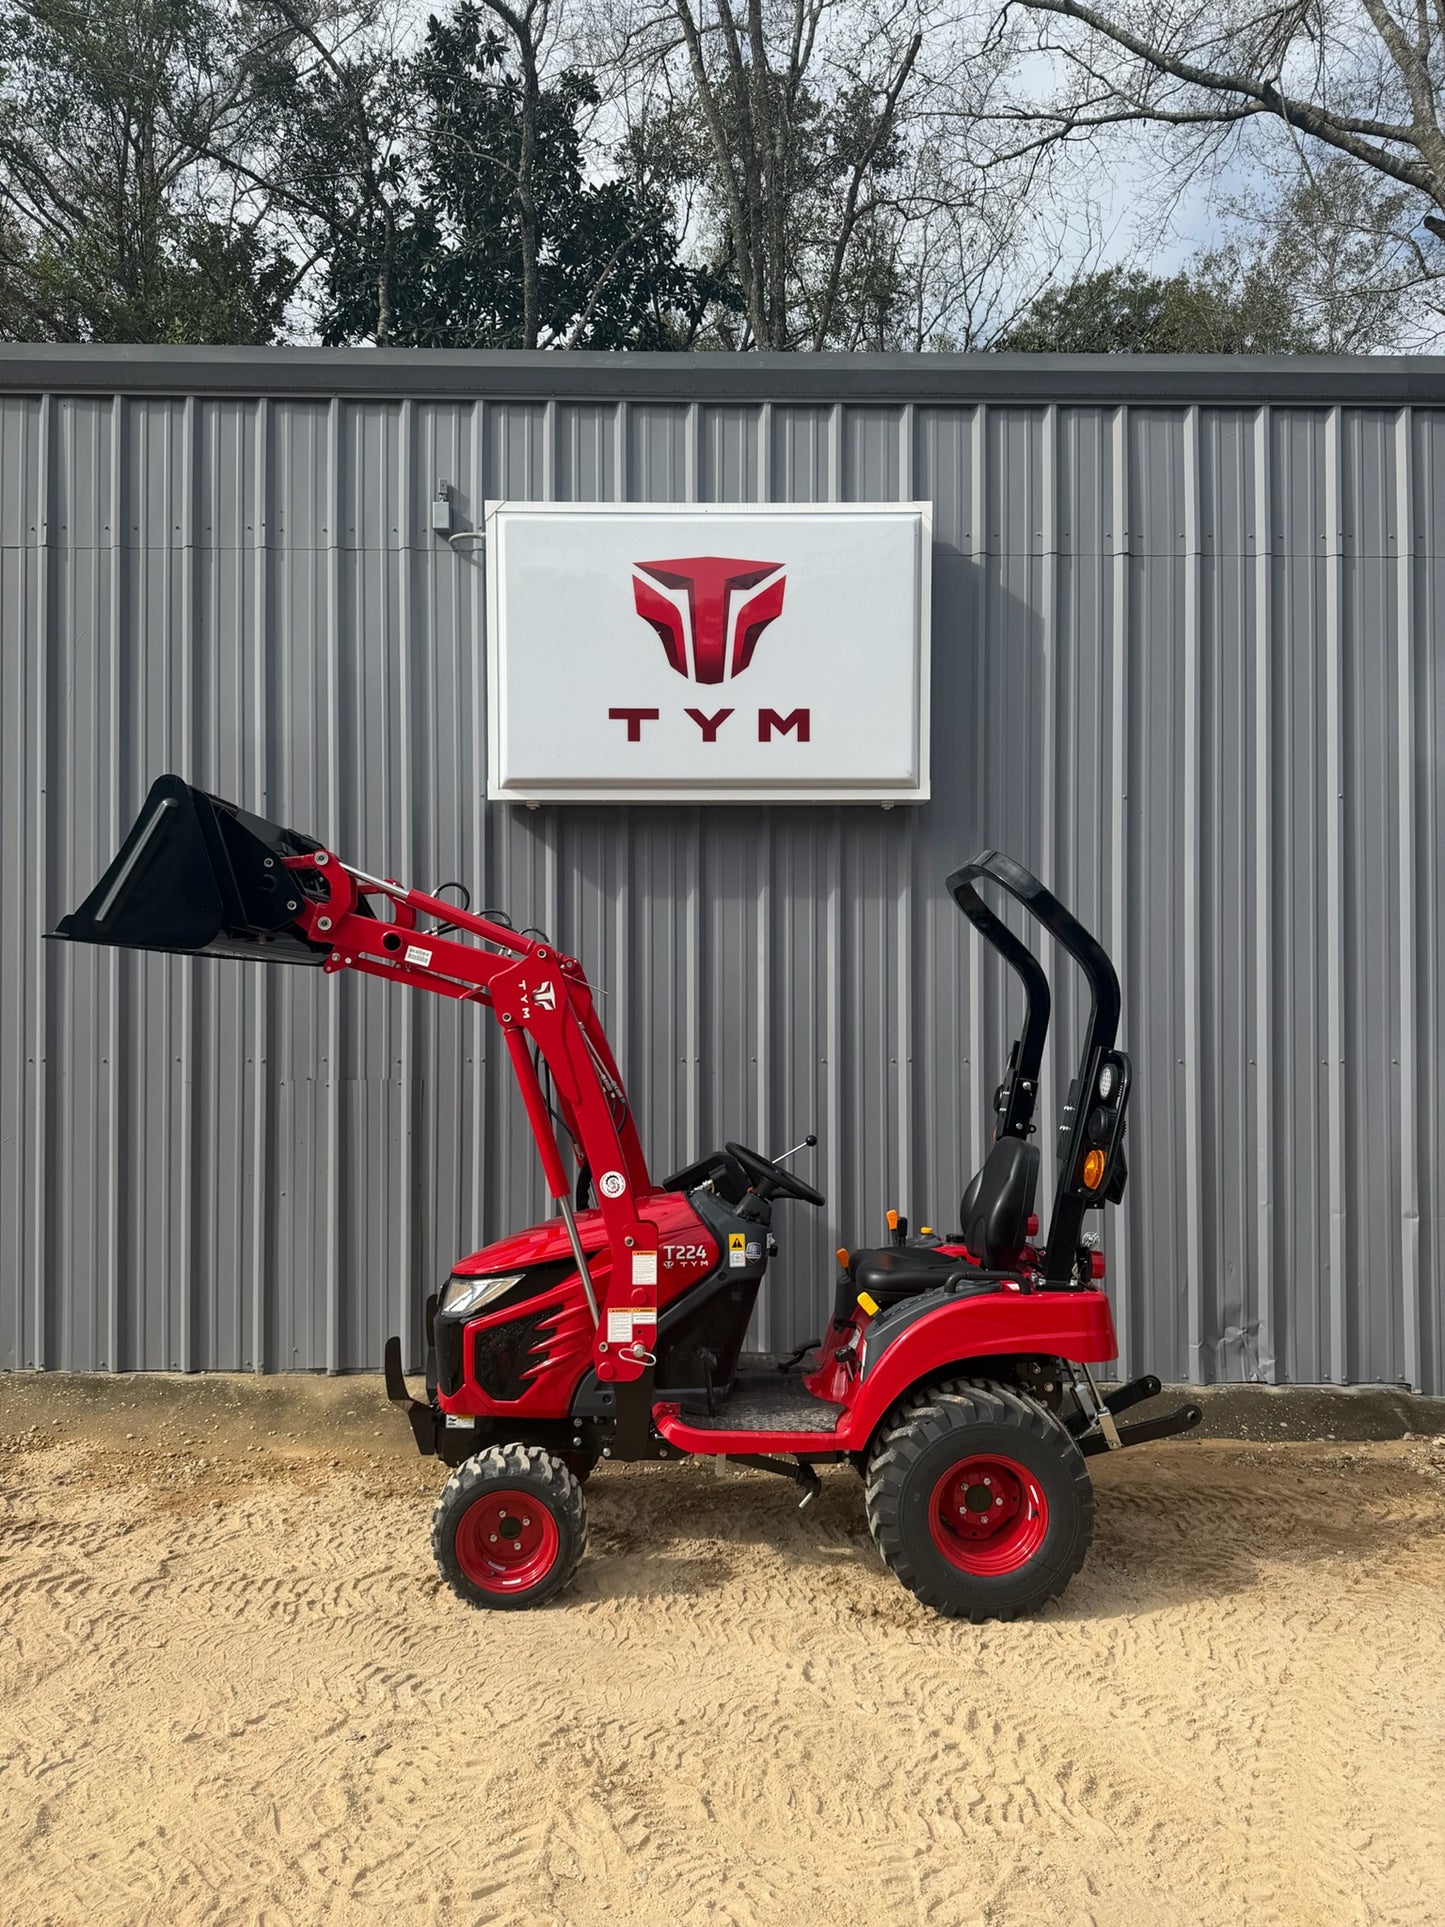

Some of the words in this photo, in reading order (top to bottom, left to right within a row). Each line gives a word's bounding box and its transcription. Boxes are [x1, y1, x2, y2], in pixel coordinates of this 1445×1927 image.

[608, 707, 810, 742] TYM
[518, 980, 531, 1019] TYM
[663, 1245, 707, 1260] T224
[680, 1260, 709, 1268] TYM
